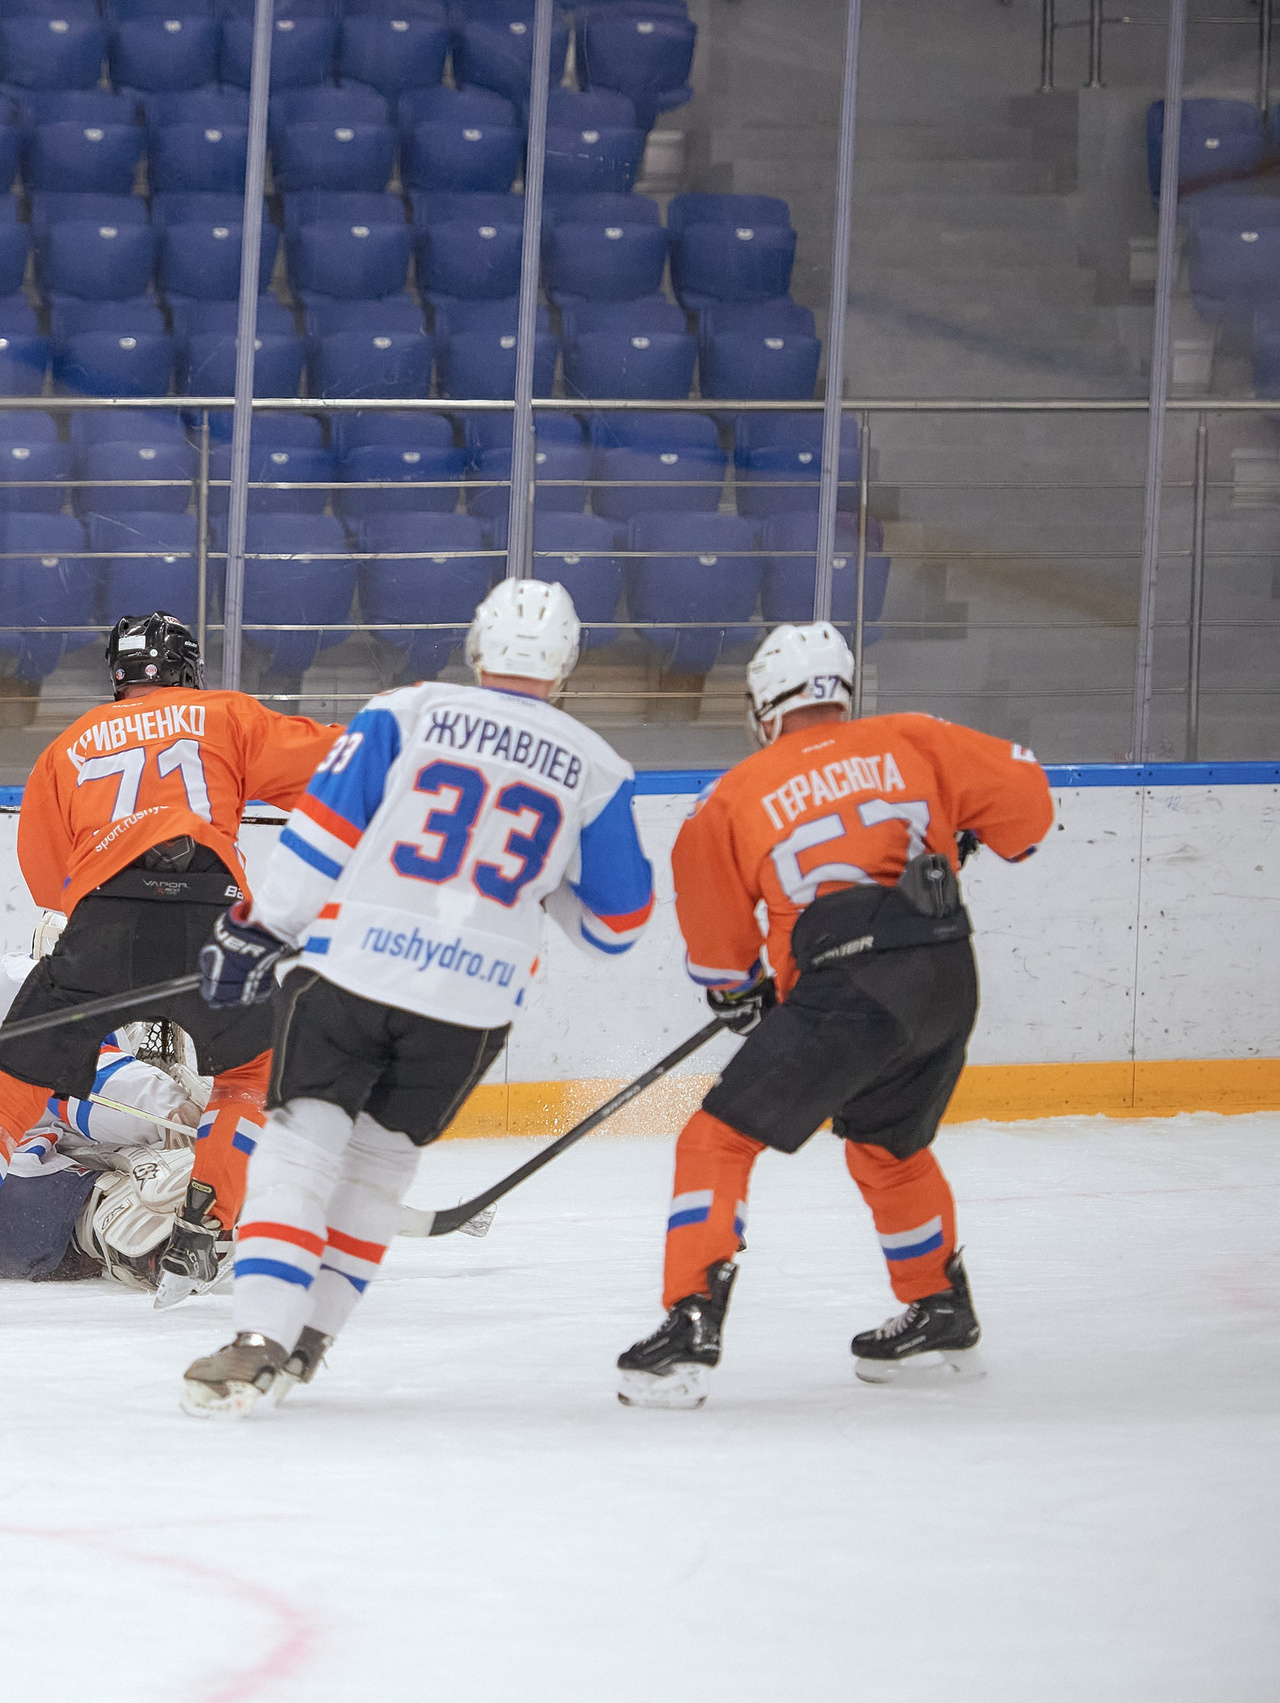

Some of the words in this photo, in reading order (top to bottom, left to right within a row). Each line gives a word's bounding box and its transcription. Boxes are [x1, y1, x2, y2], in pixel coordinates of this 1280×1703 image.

[813, 675, 841, 699] 57
[66, 705, 206, 773] КРИВЧЕНКО
[316, 731, 365, 774] 33
[424, 710, 583, 790] ЖУРАВЛЕВ
[76, 737, 214, 824] 71
[762, 753, 906, 830] ГЕРАСЮТА
[94, 804, 170, 853] sport.rushy
[389, 758, 565, 908] 33
[770, 798, 932, 904] 57
[141, 879, 192, 890] VAPOR
[361, 926, 518, 988] rushydro.ru
